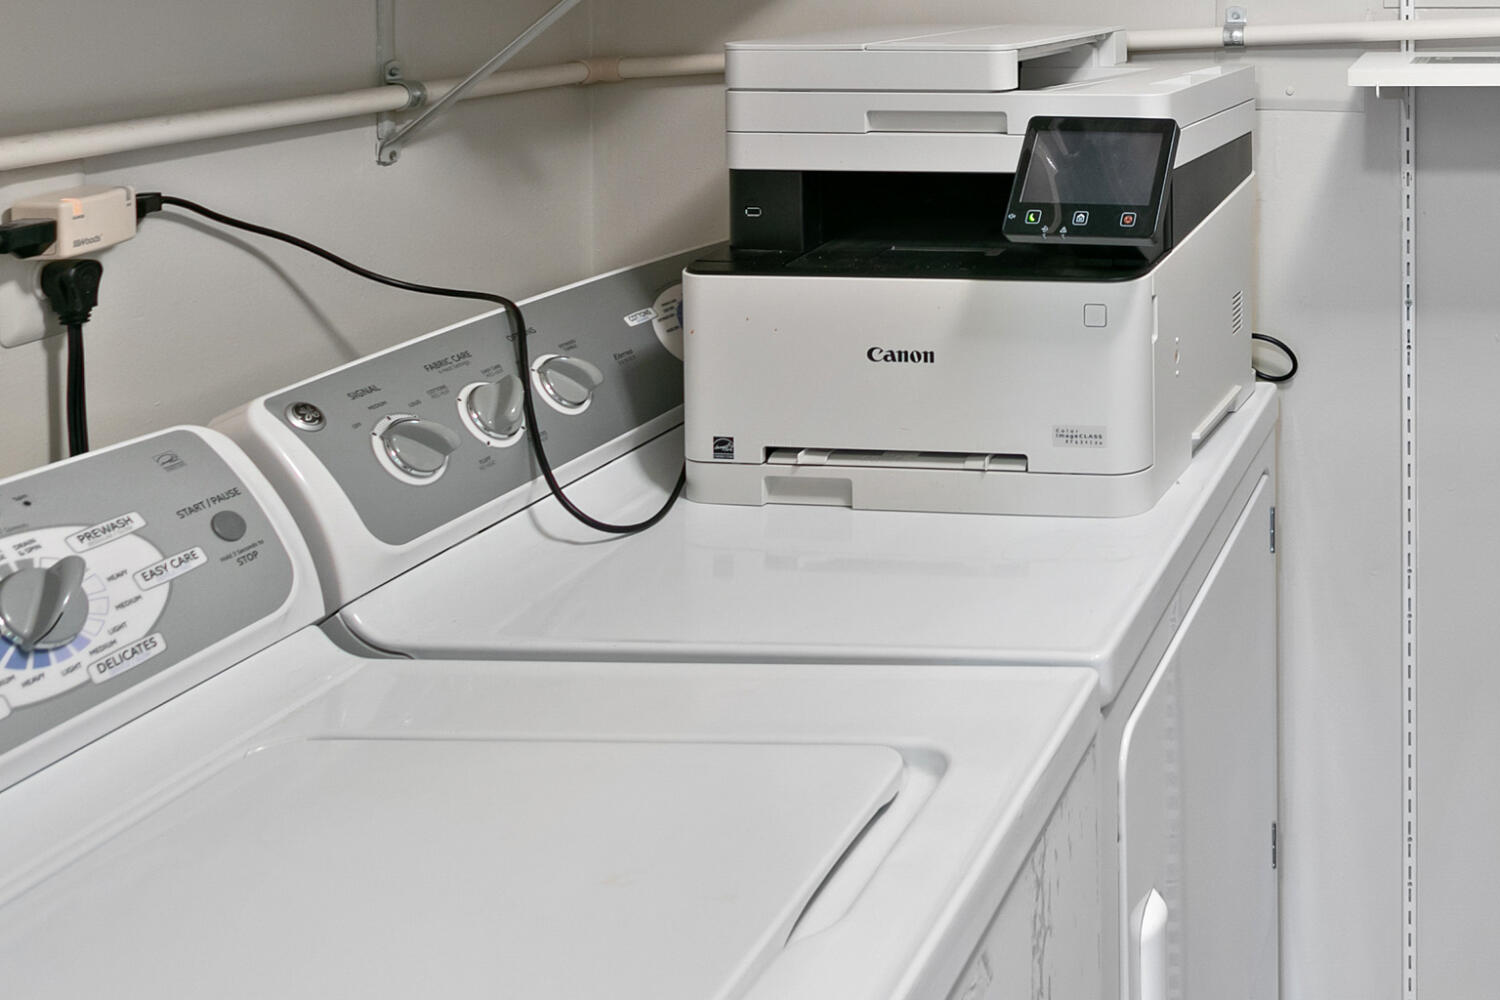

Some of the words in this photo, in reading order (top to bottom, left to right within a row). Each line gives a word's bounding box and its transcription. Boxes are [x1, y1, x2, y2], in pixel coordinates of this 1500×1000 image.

[423, 356, 451, 373] FABRIC
[450, 350, 473, 363] CARE
[867, 346, 935, 364] Canon
[347, 384, 382, 401] SIGNAL
[76, 514, 135, 544] PREWASH
[140, 561, 169, 583] EASY
[170, 550, 199, 569] CARE
[236, 550, 259, 567] STOP
[115, 594, 143, 611] MEDIUM
[107, 621, 128, 635] LIGHT
[88, 639, 118, 656] MEDIUM
[96, 636, 158, 674] DELICATES
[61, 662, 83, 677] LIGHT
[21, 672, 46, 688] HEAVY
